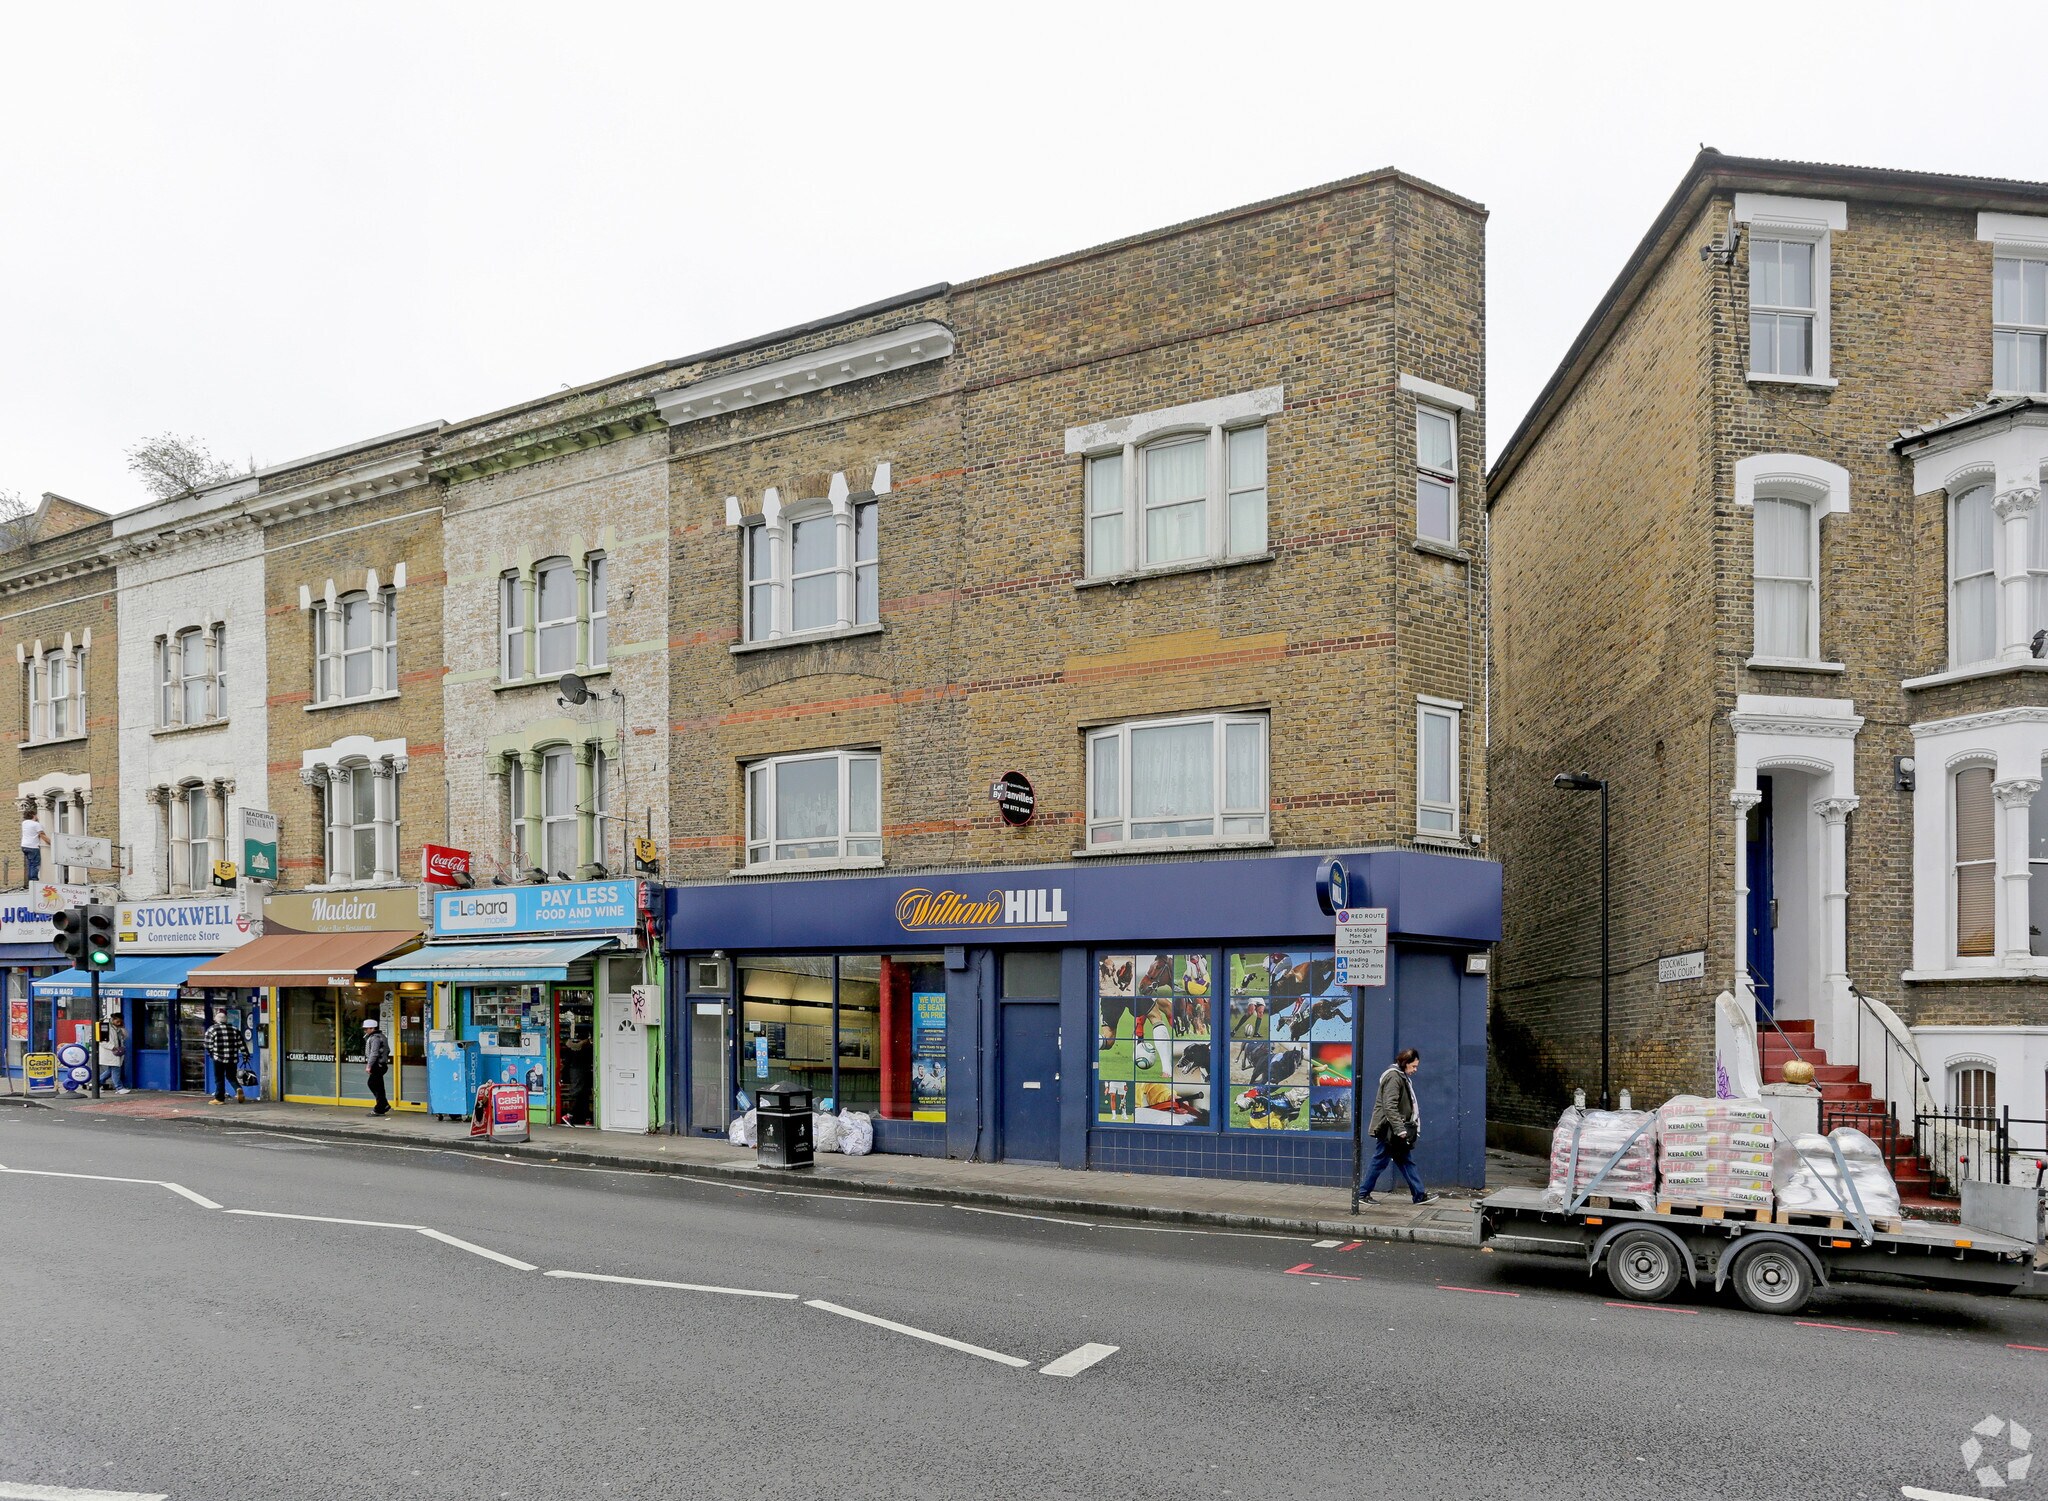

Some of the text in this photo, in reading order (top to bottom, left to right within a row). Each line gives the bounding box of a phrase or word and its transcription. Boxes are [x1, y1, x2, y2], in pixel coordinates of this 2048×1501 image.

[992, 791, 1002, 800] By
[1006, 791, 1034, 804] ranvilles
[246, 811, 274, 820] MADEIRA
[246, 817, 274, 829] RESTAURANT
[541, 886, 618, 906] PAY LESS
[312, 896, 377, 920] Madeira
[460, 900, 507, 916] Lebara
[536, 906, 624, 920] FOOD AND WINE
[895, 888, 1067, 926] William HILL
[2, 907, 53, 923] JJ Chicke
[136, 905, 232, 927] STOCKWELL
[148, 932, 196, 941] Convenience
[199, 931, 220, 940] Store
[1660, 957, 1688, 970] STOCKWELL
[1660, 966, 1696, 979] GREEN COURT
[328, 977, 349, 985] Madeira
[498, 1094, 523, 1104] cash
[1732, 1140, 1769, 1148] KERAKOLL
[1732, 1168, 1769, 1177] KERAKOLL
[1731, 1192, 1766, 1202] KERAKOLL
